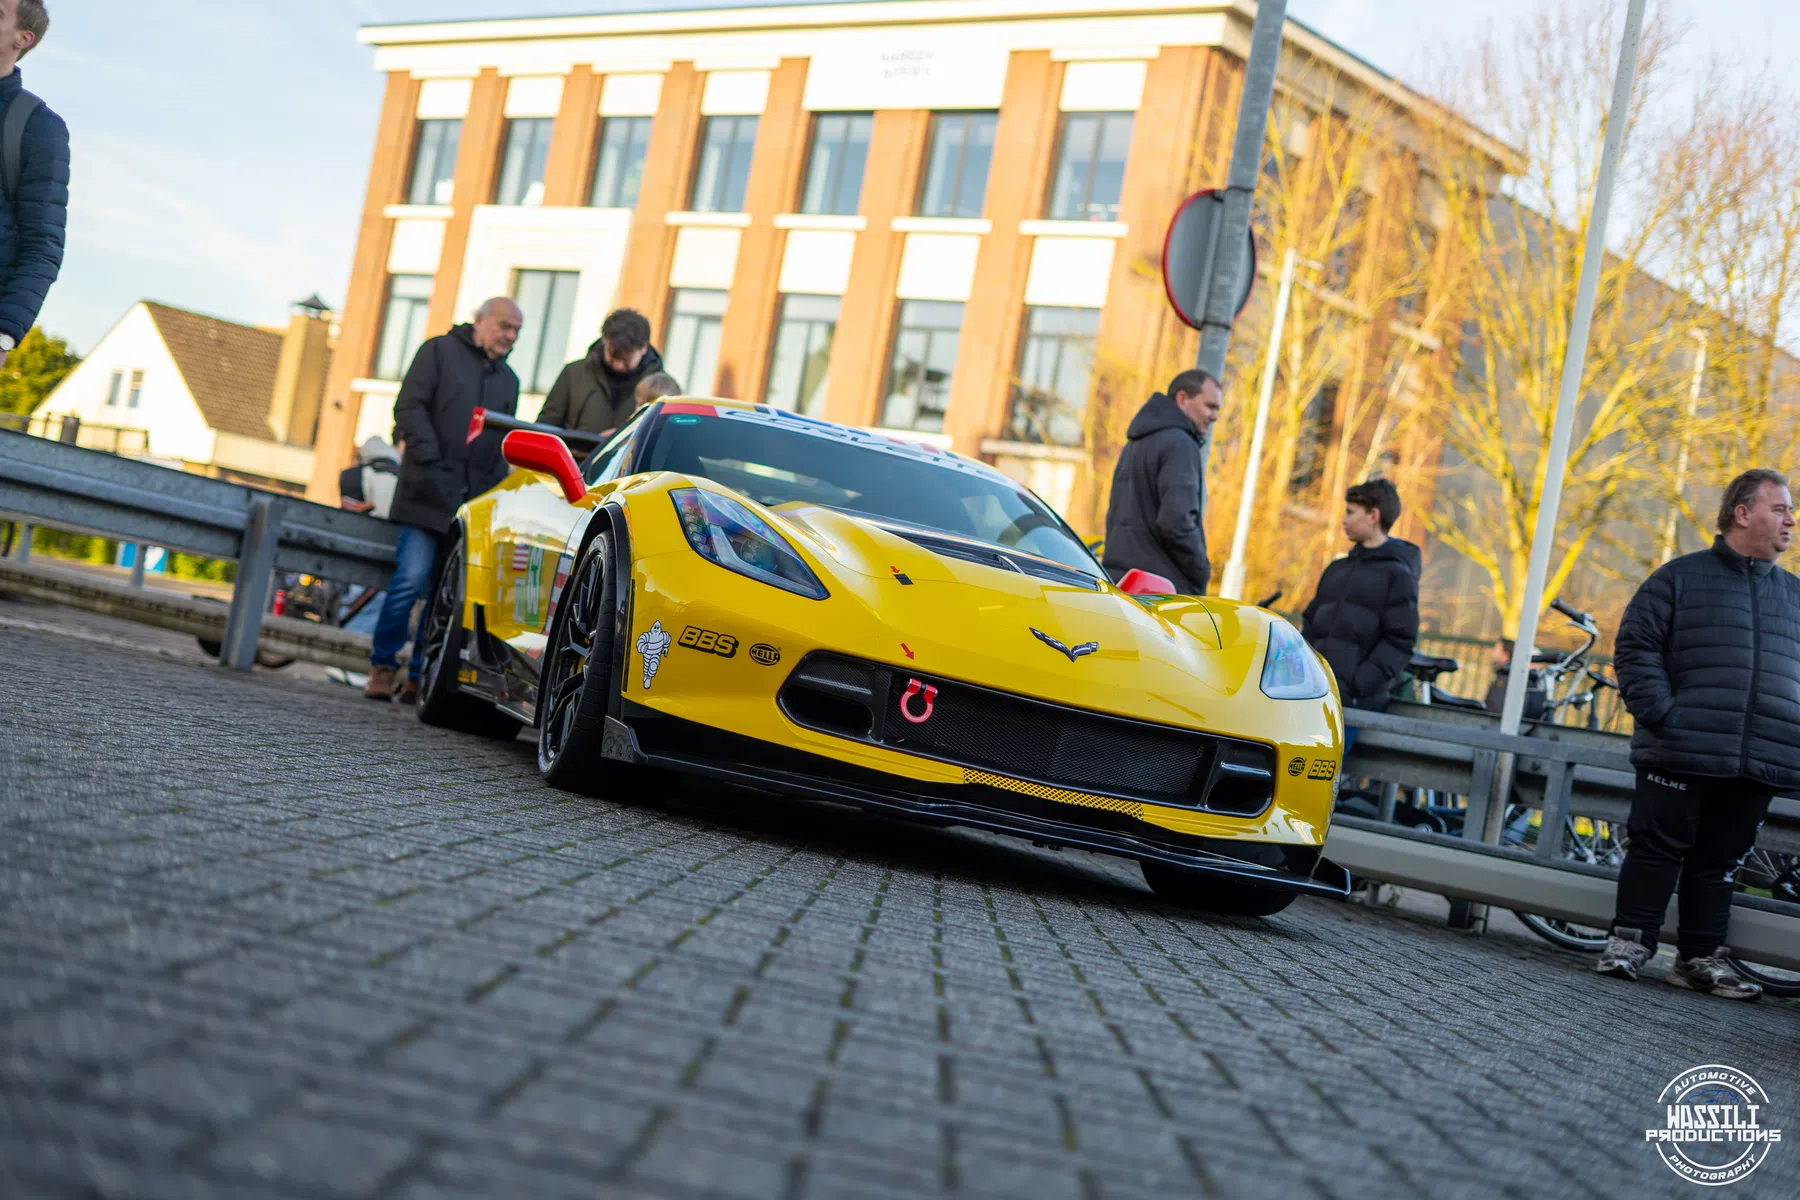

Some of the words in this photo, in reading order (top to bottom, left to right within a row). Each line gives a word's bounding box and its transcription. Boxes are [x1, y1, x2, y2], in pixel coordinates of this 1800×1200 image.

[678, 625, 739, 658] BBS
[750, 645, 780, 663] HELLA
[1307, 759, 1336, 780] BBS
[1647, 772, 1687, 790] KELME
